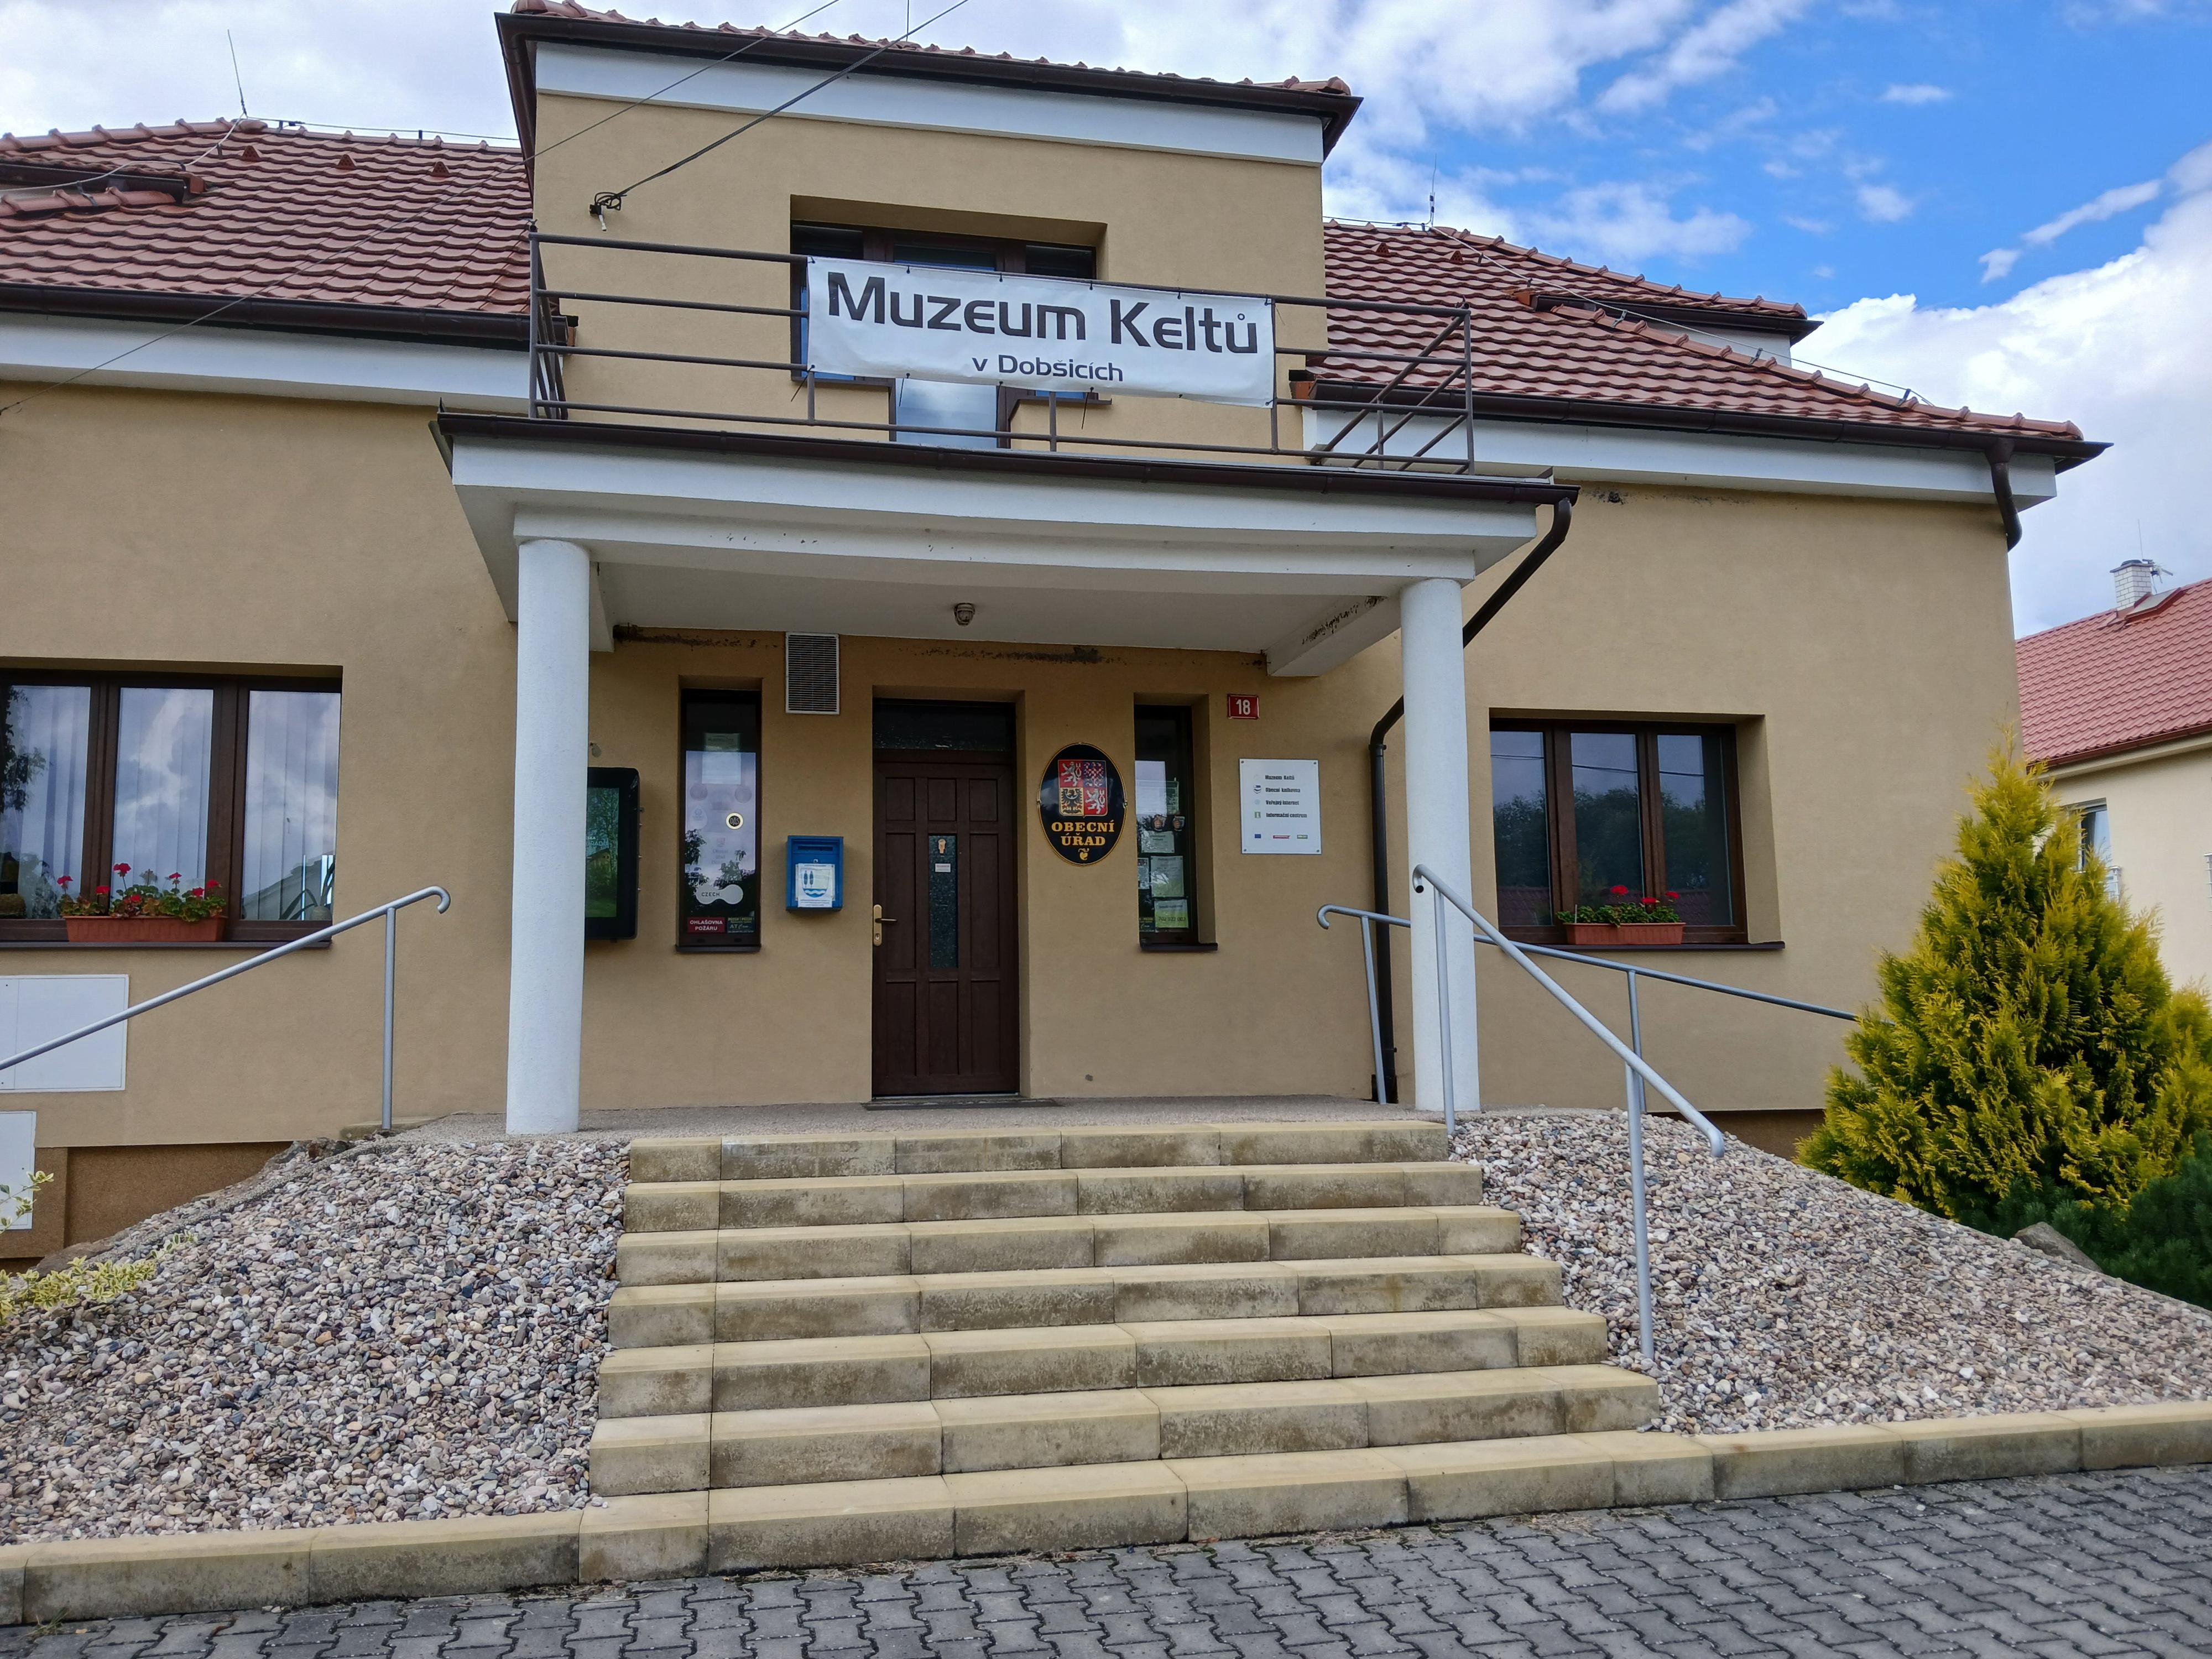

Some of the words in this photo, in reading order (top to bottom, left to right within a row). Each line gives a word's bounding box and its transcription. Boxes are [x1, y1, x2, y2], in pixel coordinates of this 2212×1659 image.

[828, 272, 1086, 340] Muzeum
[1110, 299, 1258, 353] Keltů
[972, 357, 988, 371] v
[998, 354, 1123, 382] Dobšicích
[1235, 699, 1251, 715] 18
[1051, 820, 1115, 832] OBECNÍ
[1061, 833, 1105, 846] ÚŘAD
